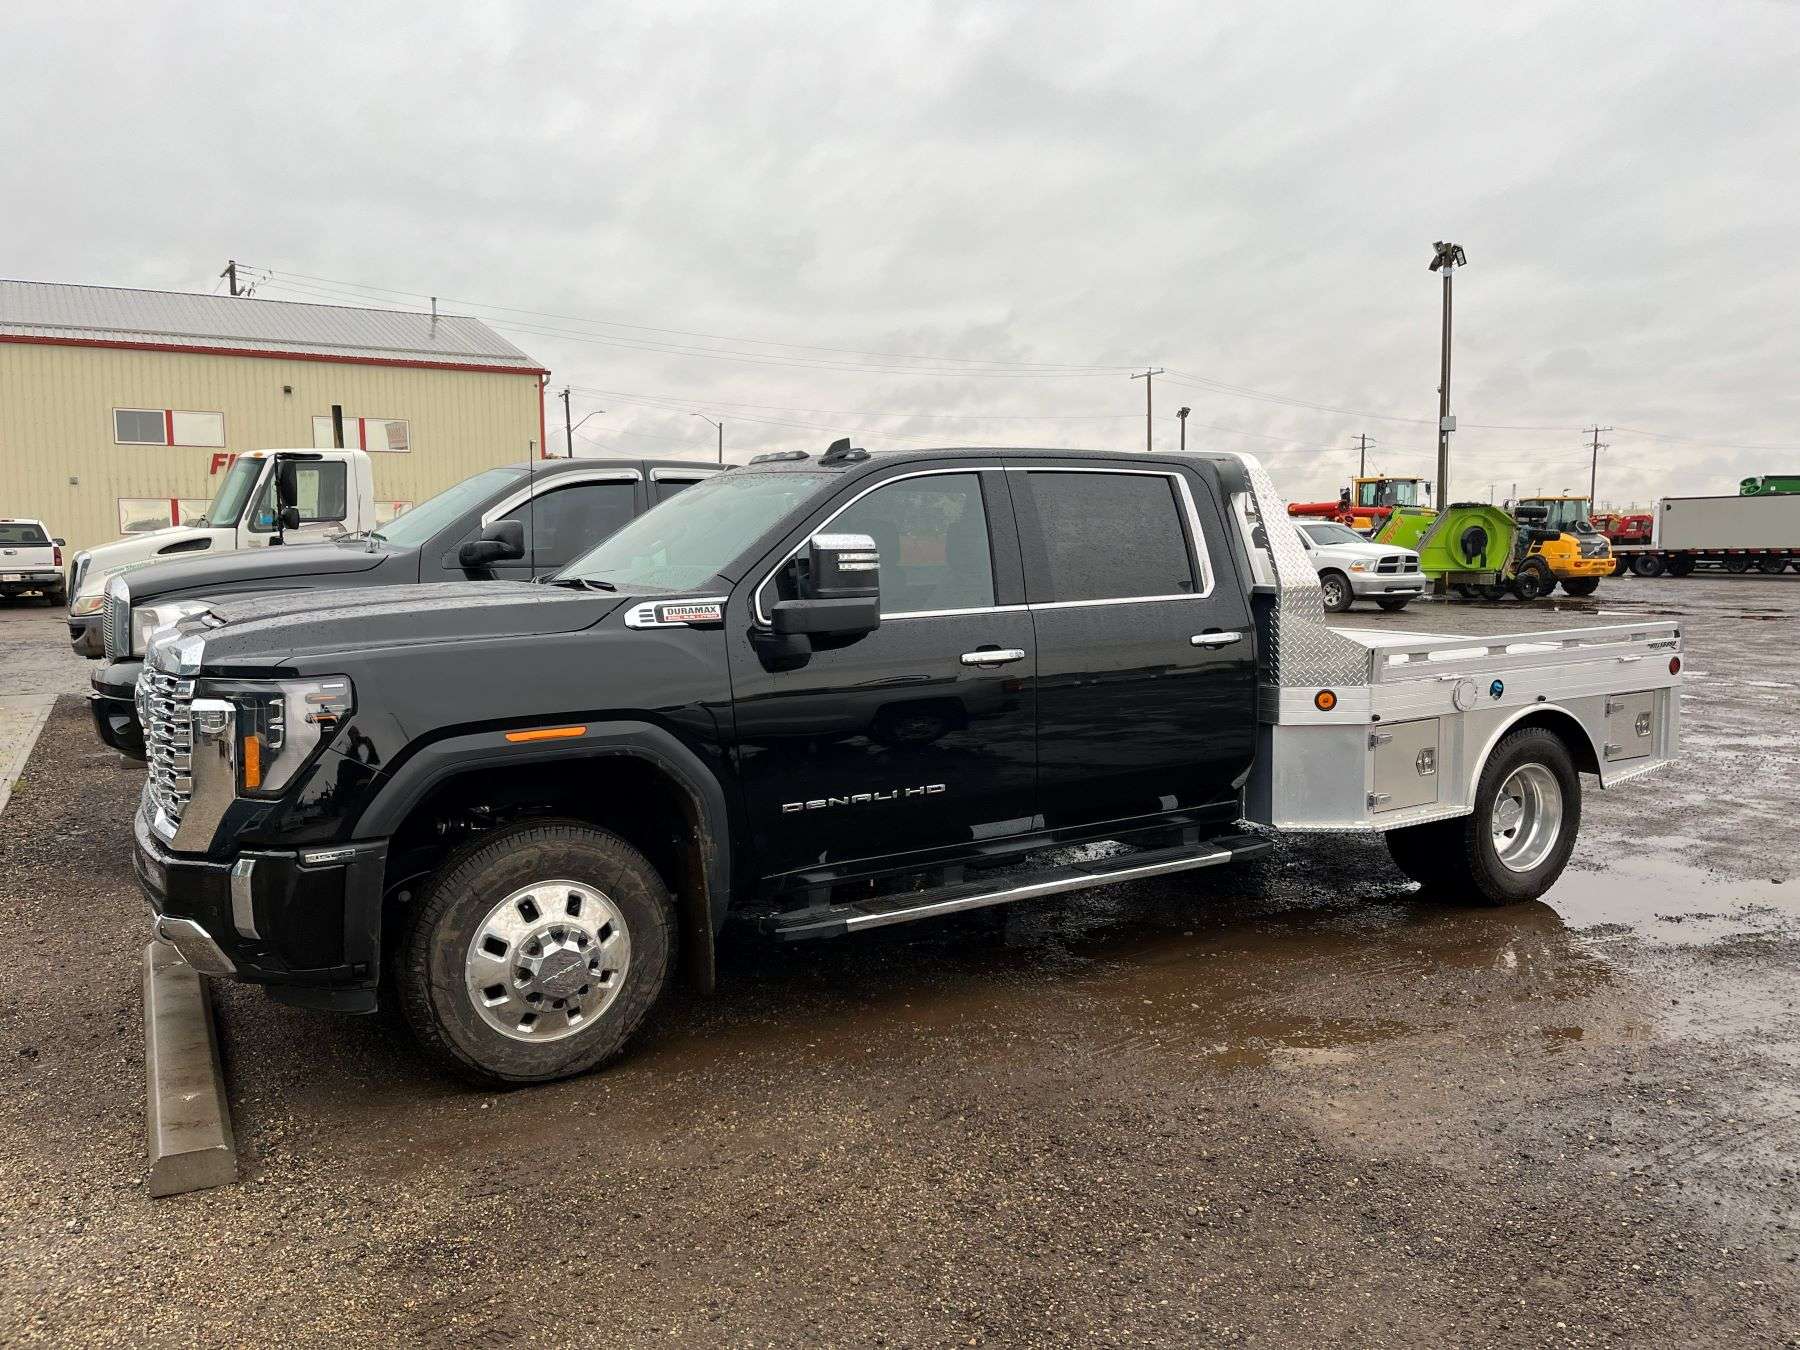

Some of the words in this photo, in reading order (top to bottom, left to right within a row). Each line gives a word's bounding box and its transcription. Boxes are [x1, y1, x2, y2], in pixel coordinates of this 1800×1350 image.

[667, 606, 717, 616] DURAMAX
[782, 790, 898, 813] DENALI
[905, 783, 946, 797] HD
